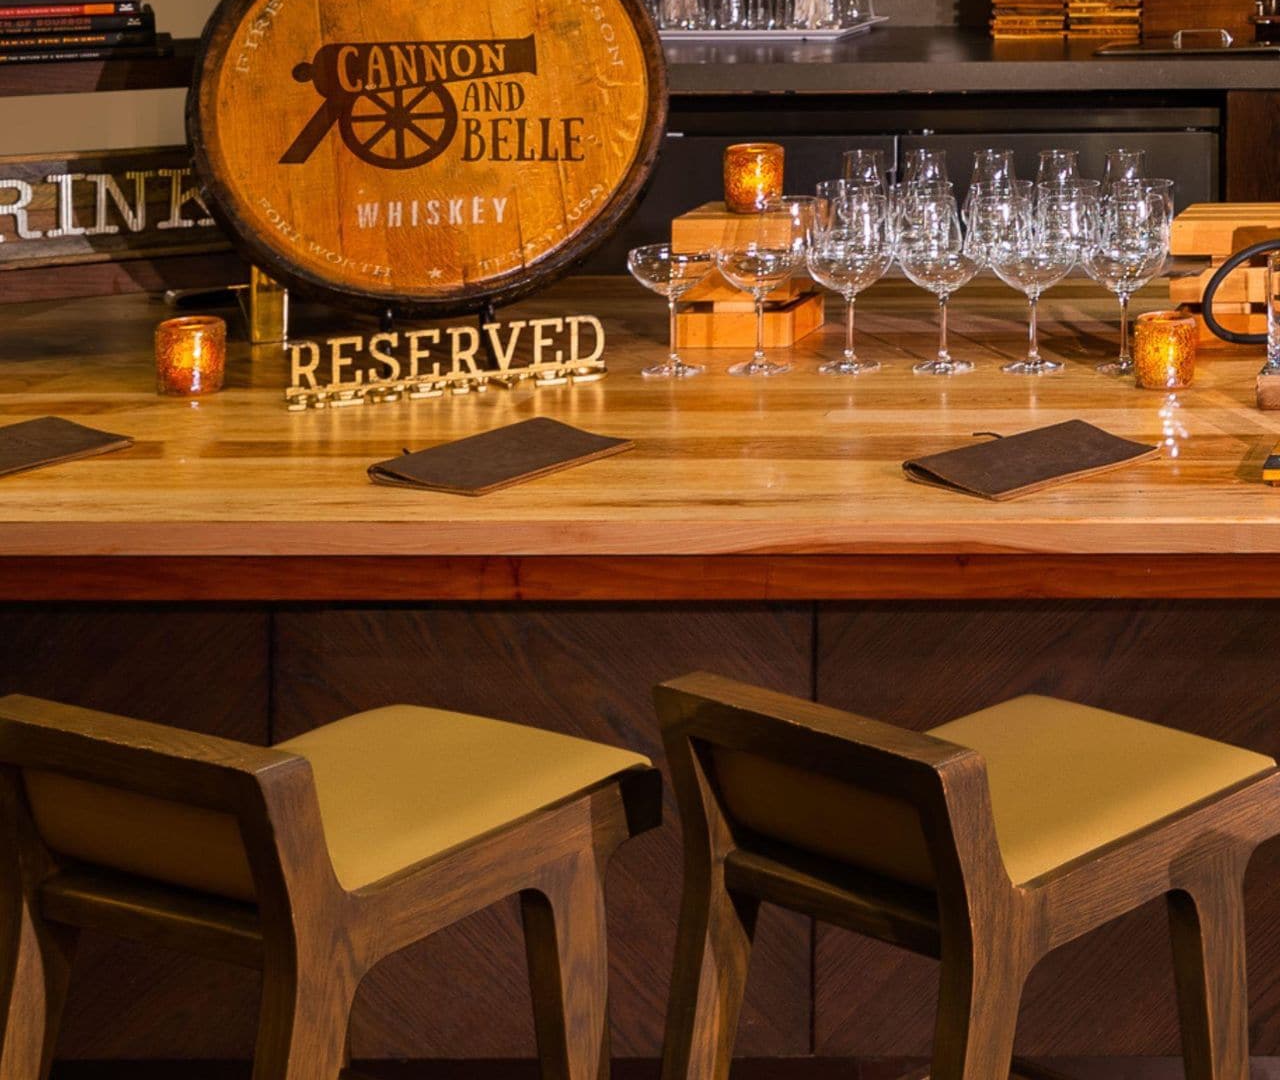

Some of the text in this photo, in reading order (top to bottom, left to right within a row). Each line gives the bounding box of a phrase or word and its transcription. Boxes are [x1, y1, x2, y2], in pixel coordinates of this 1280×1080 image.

[337, 43, 507, 93] CANNON
[461, 81, 526, 112] AND
[461, 117, 586, 161] BELLE
[257, 197, 301, 243] FORT
[308, 241, 392, 278] WORTH
[567, 184, 604, 221] USA
[356, 195, 509, 230] WHISKEY
[286, 314, 606, 398] RESERVED
